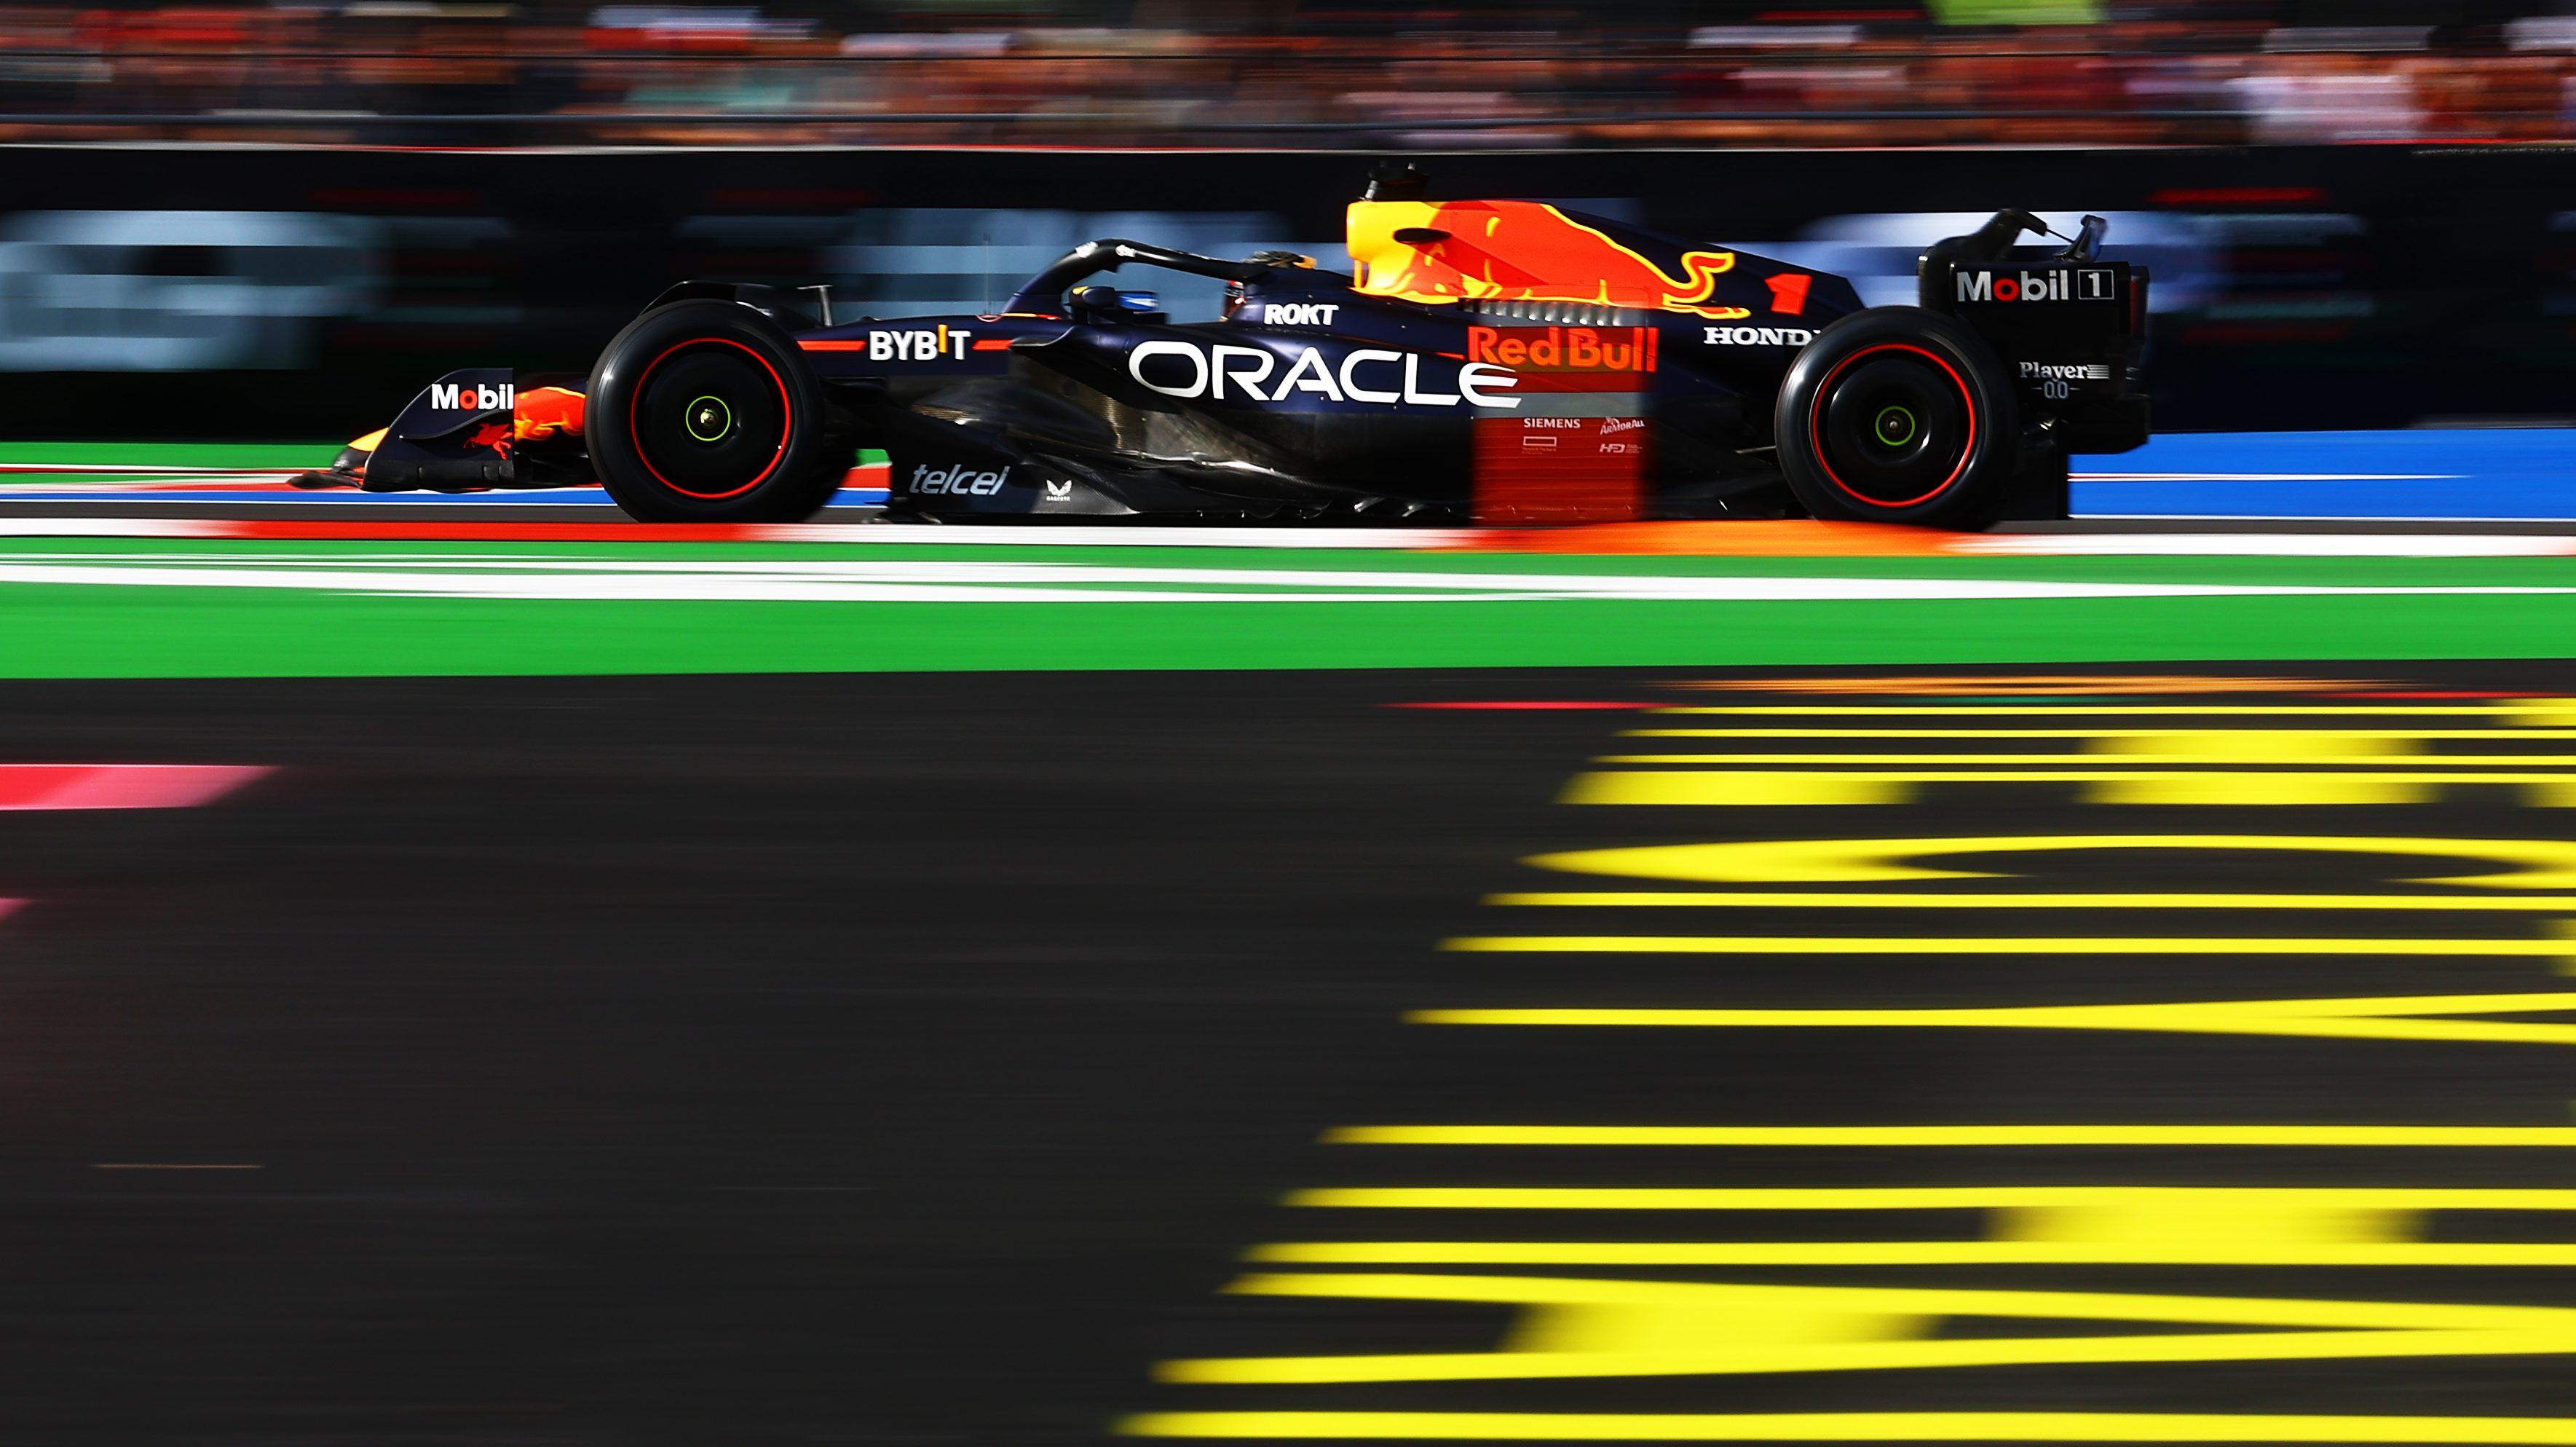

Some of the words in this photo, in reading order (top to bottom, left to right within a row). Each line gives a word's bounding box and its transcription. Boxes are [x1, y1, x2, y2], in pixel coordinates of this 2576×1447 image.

[1766, 273, 1812, 315] 1
[1956, 269, 2069, 301] Mobil
[2088, 272, 2101, 297] 1
[1264, 303, 1340, 326] ROKT
[869, 324, 972, 360] BYBIT
[1468, 326, 1561, 366] Red
[1568, 327, 1659, 373] Bull
[1703, 326, 1821, 346] HOND
[1129, 339, 1522, 409] ORACLE
[431, 383, 514, 410] Mobil
[1524, 417, 1581, 429] SIEMENS
[909, 464, 1011, 496] telcel
